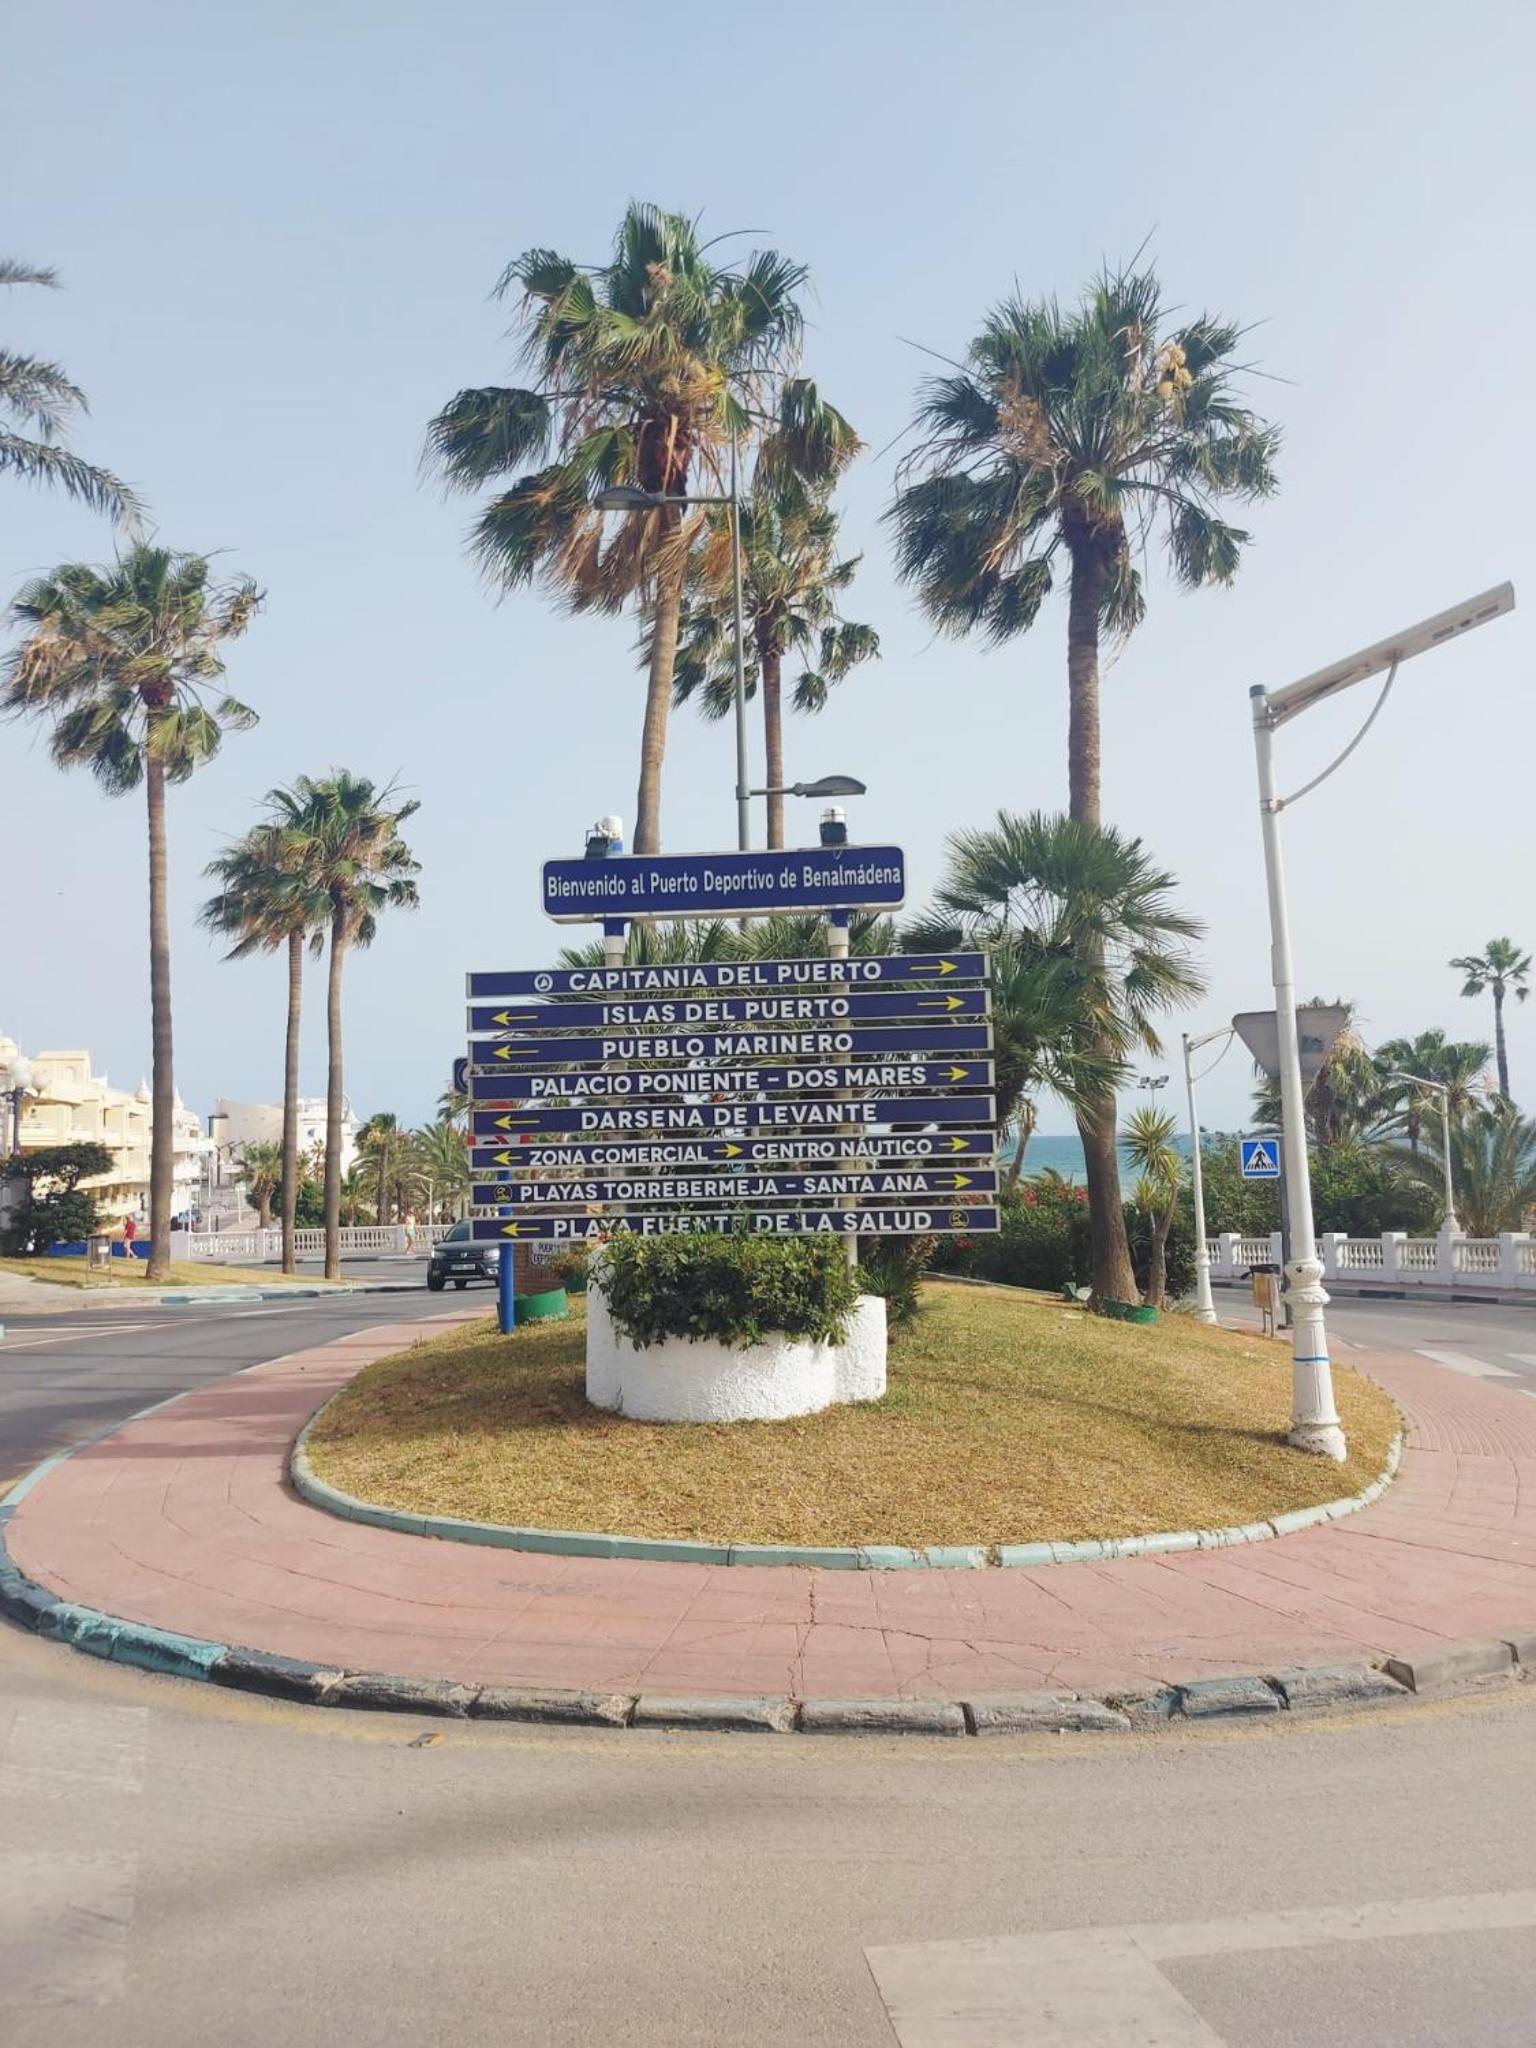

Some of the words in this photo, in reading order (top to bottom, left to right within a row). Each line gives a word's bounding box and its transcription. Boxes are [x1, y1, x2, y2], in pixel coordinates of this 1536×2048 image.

[548, 875, 626, 898] Bienvenido
[632, 876, 645, 894] al
[650, 872, 698, 894] Puerto
[704, 870, 774, 893] Deportivo
[779, 867, 796, 889] de
[803, 864, 901, 887] Benalmádena
[569, 968, 707, 990] CAPITANIA
[717, 966, 768, 986] DEL
[778, 961, 881, 982] PUERTO
[603, 1004, 676, 1023] ISLAS
[685, 1001, 736, 1021] DEL
[746, 998, 849, 1019] PUERTO
[603, 1038, 703, 1059] PUEBLO
[715, 1034, 853, 1054] MARINERO
[531, 1075, 632, 1097] PALACIO
[639, 1071, 759, 1092] PONIENTE
[787, 1069, 838, 1089] DOS
[845, 1067, 926, 1086] MARES
[581, 1109, 704, 1130] DARSENA
[715, 1107, 747, 1126] DE
[758, 1103, 877, 1124] LEVANTE
[529, 1149, 585, 1166] ZONA
[591, 1145, 708, 1164] COMERCIAL
[752, 1141, 835, 1160] CENTRO
[841, 1136, 932, 1157] NÁUTICO
[520, 1183, 597, 1201] PLAYAS
[604, 1178, 777, 1198] TORREBERMEJA
[804, 1175, 876, 1193] SANTA
[882, 1173, 927, 1191] ANA
[553, 1219, 632, 1238] PLAYA
[756, 1215, 792, 1231] DE
[801, 1213, 833, 1231] LA
[844, 1212, 931, 1230] SALUD
